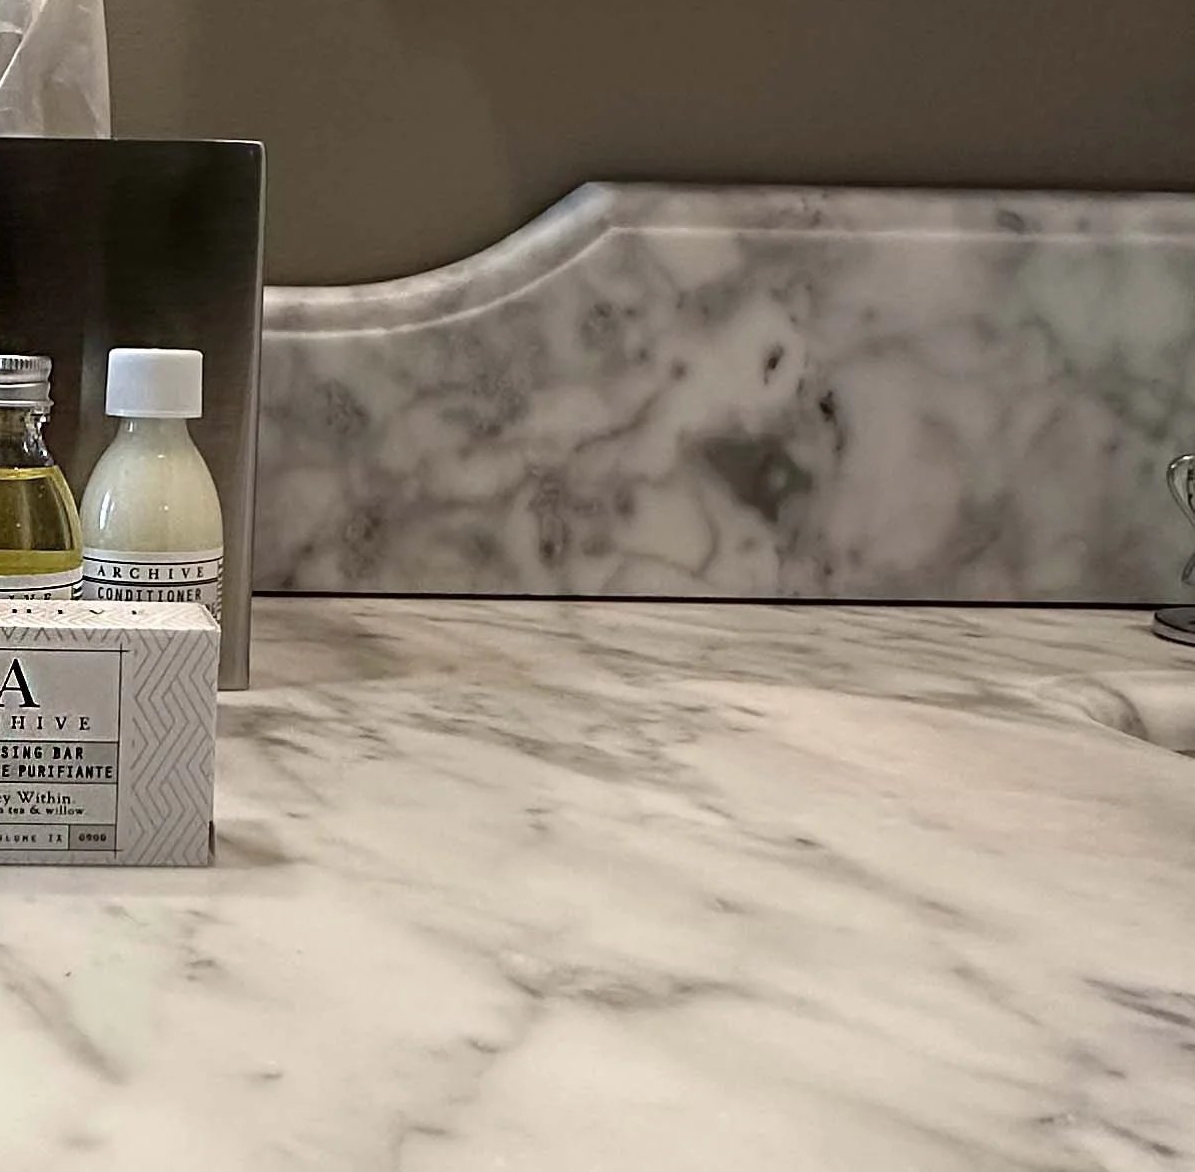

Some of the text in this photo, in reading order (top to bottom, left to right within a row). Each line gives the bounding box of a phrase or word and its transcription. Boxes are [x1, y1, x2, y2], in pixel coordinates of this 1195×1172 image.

[97, 565, 204, 580] ARCHIVE
[97, 586, 202, 602] CONDITIONER
[52, 746, 84, 760] BAR
[18, 764, 114, 779] PURIFIANTE
[29, 805, 41, 815] &
